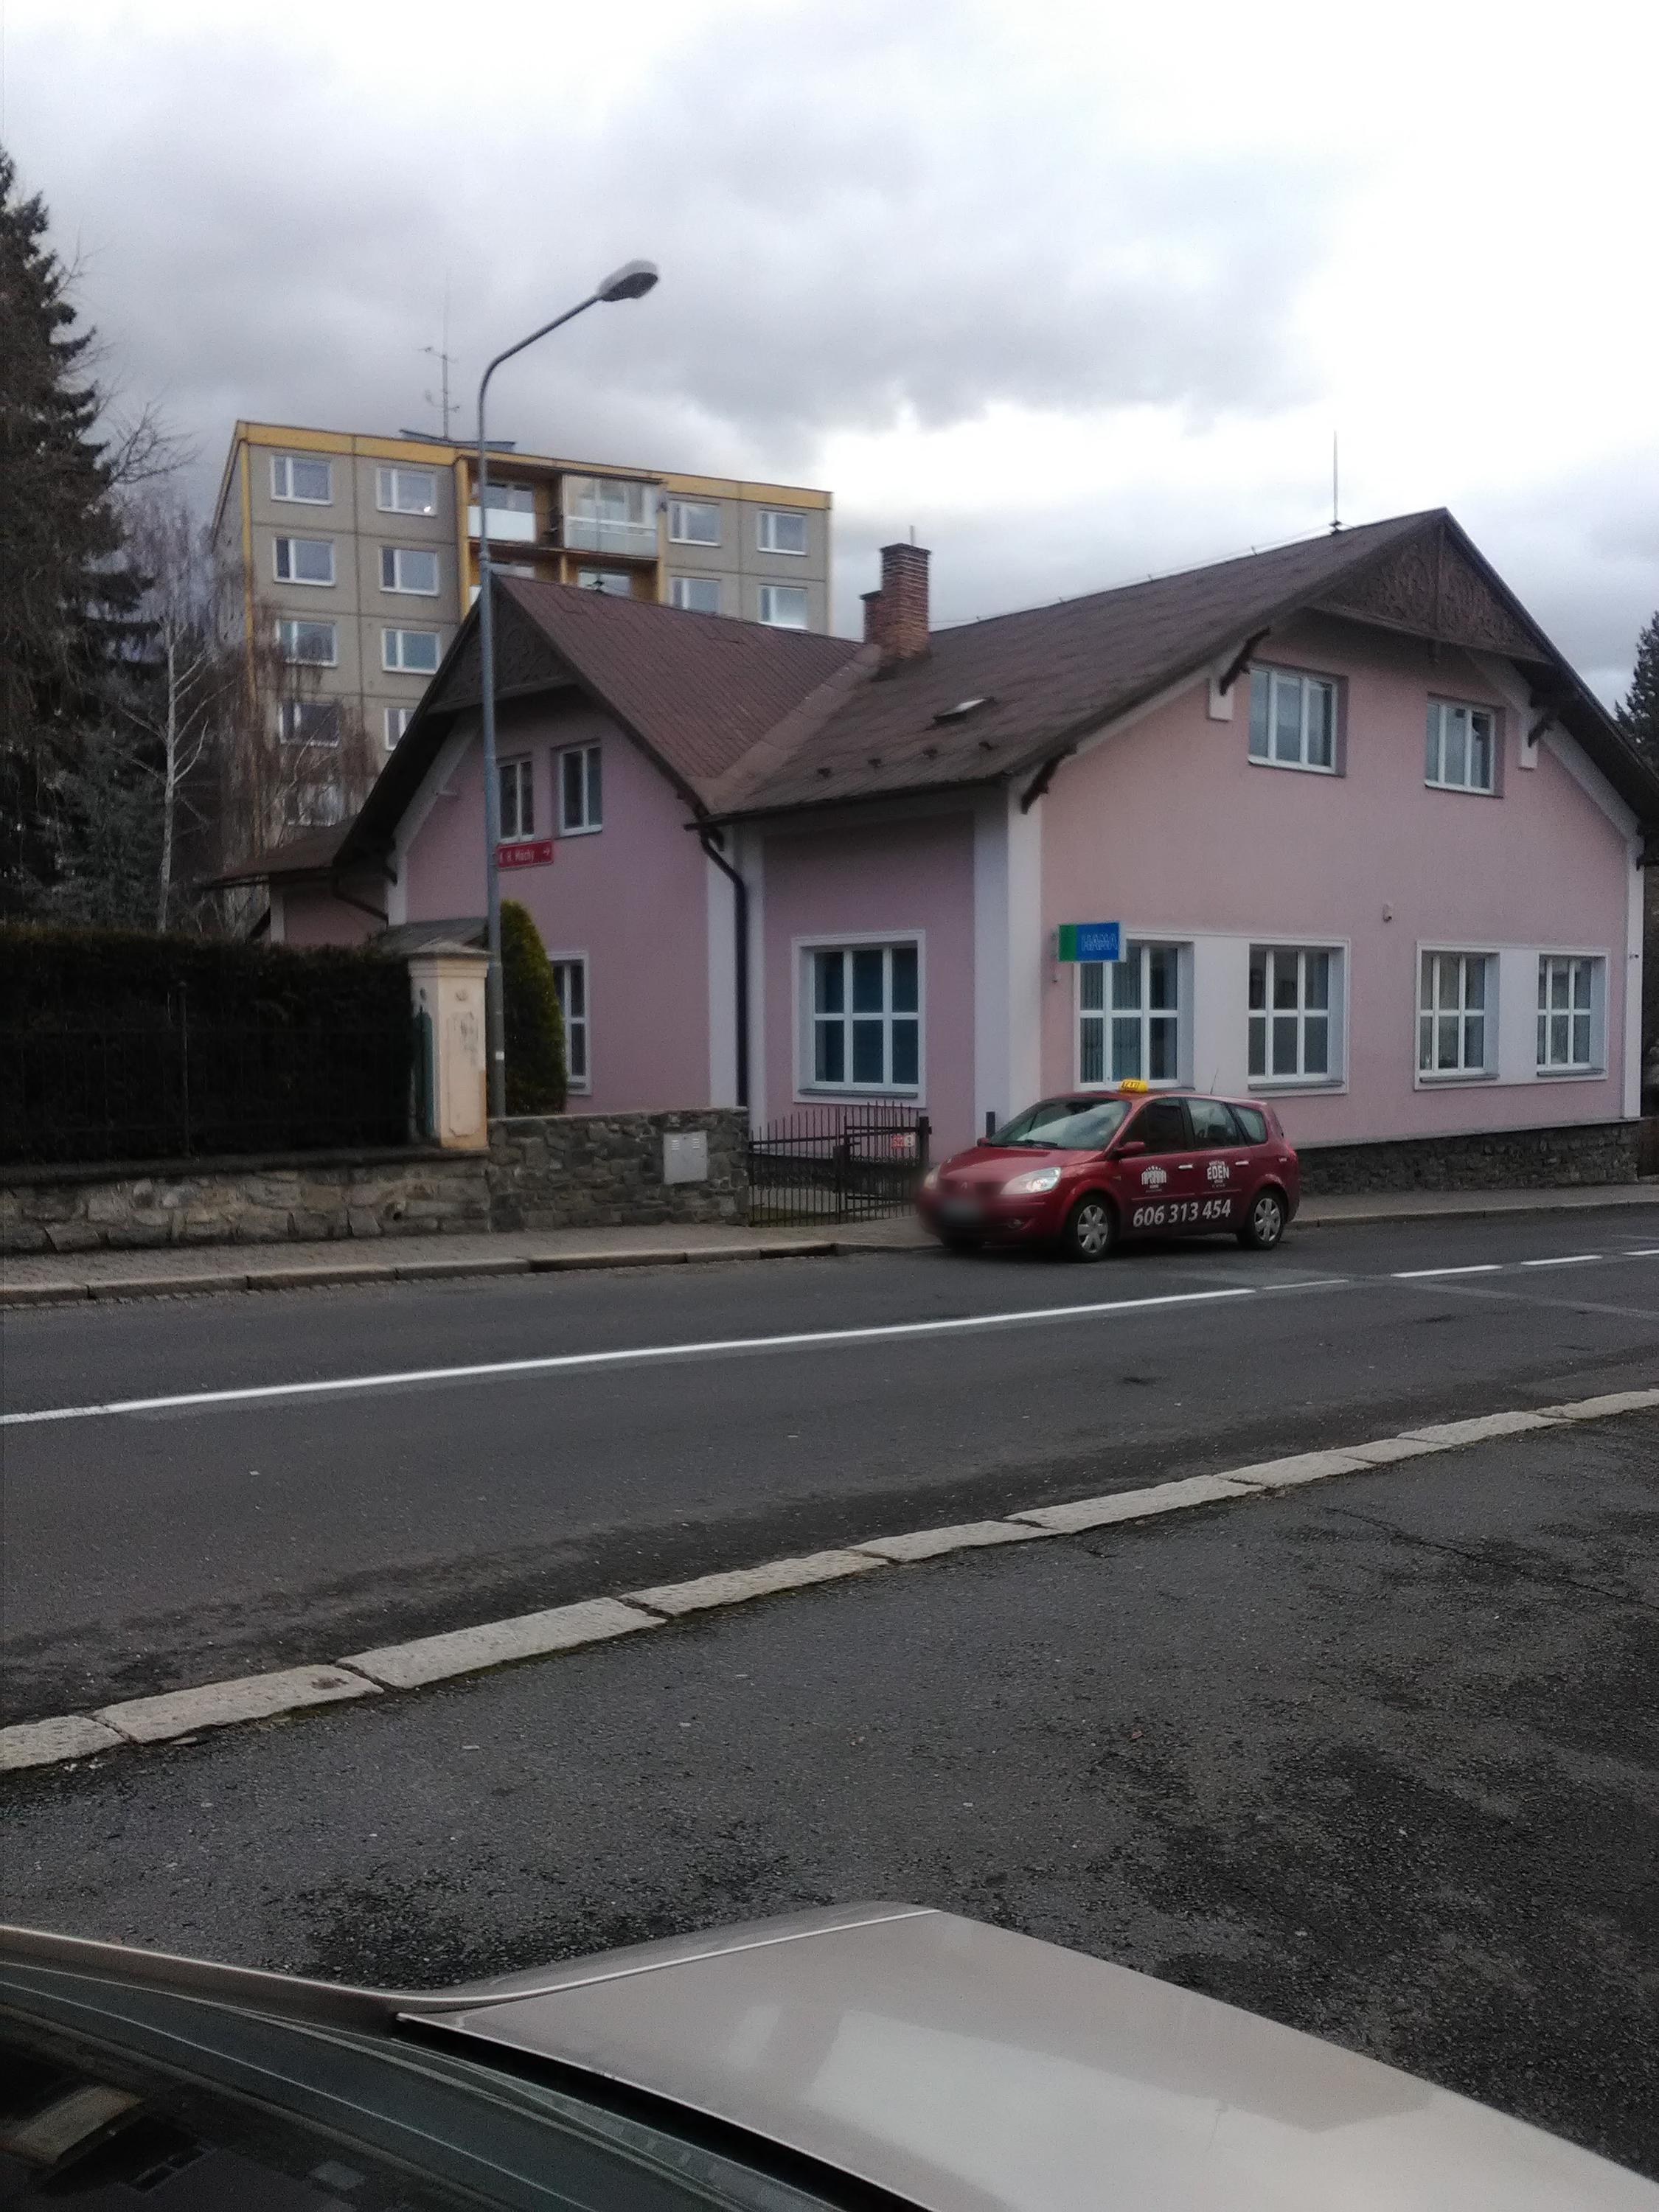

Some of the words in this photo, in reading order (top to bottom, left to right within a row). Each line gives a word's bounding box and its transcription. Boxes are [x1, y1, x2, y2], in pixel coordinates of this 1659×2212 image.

[1206, 1164, 1230, 1180] EDEN
[1133, 1205, 1165, 1227] 606
[1167, 1202, 1199, 1223] 313
[1202, 1199, 1231, 1220] 454
